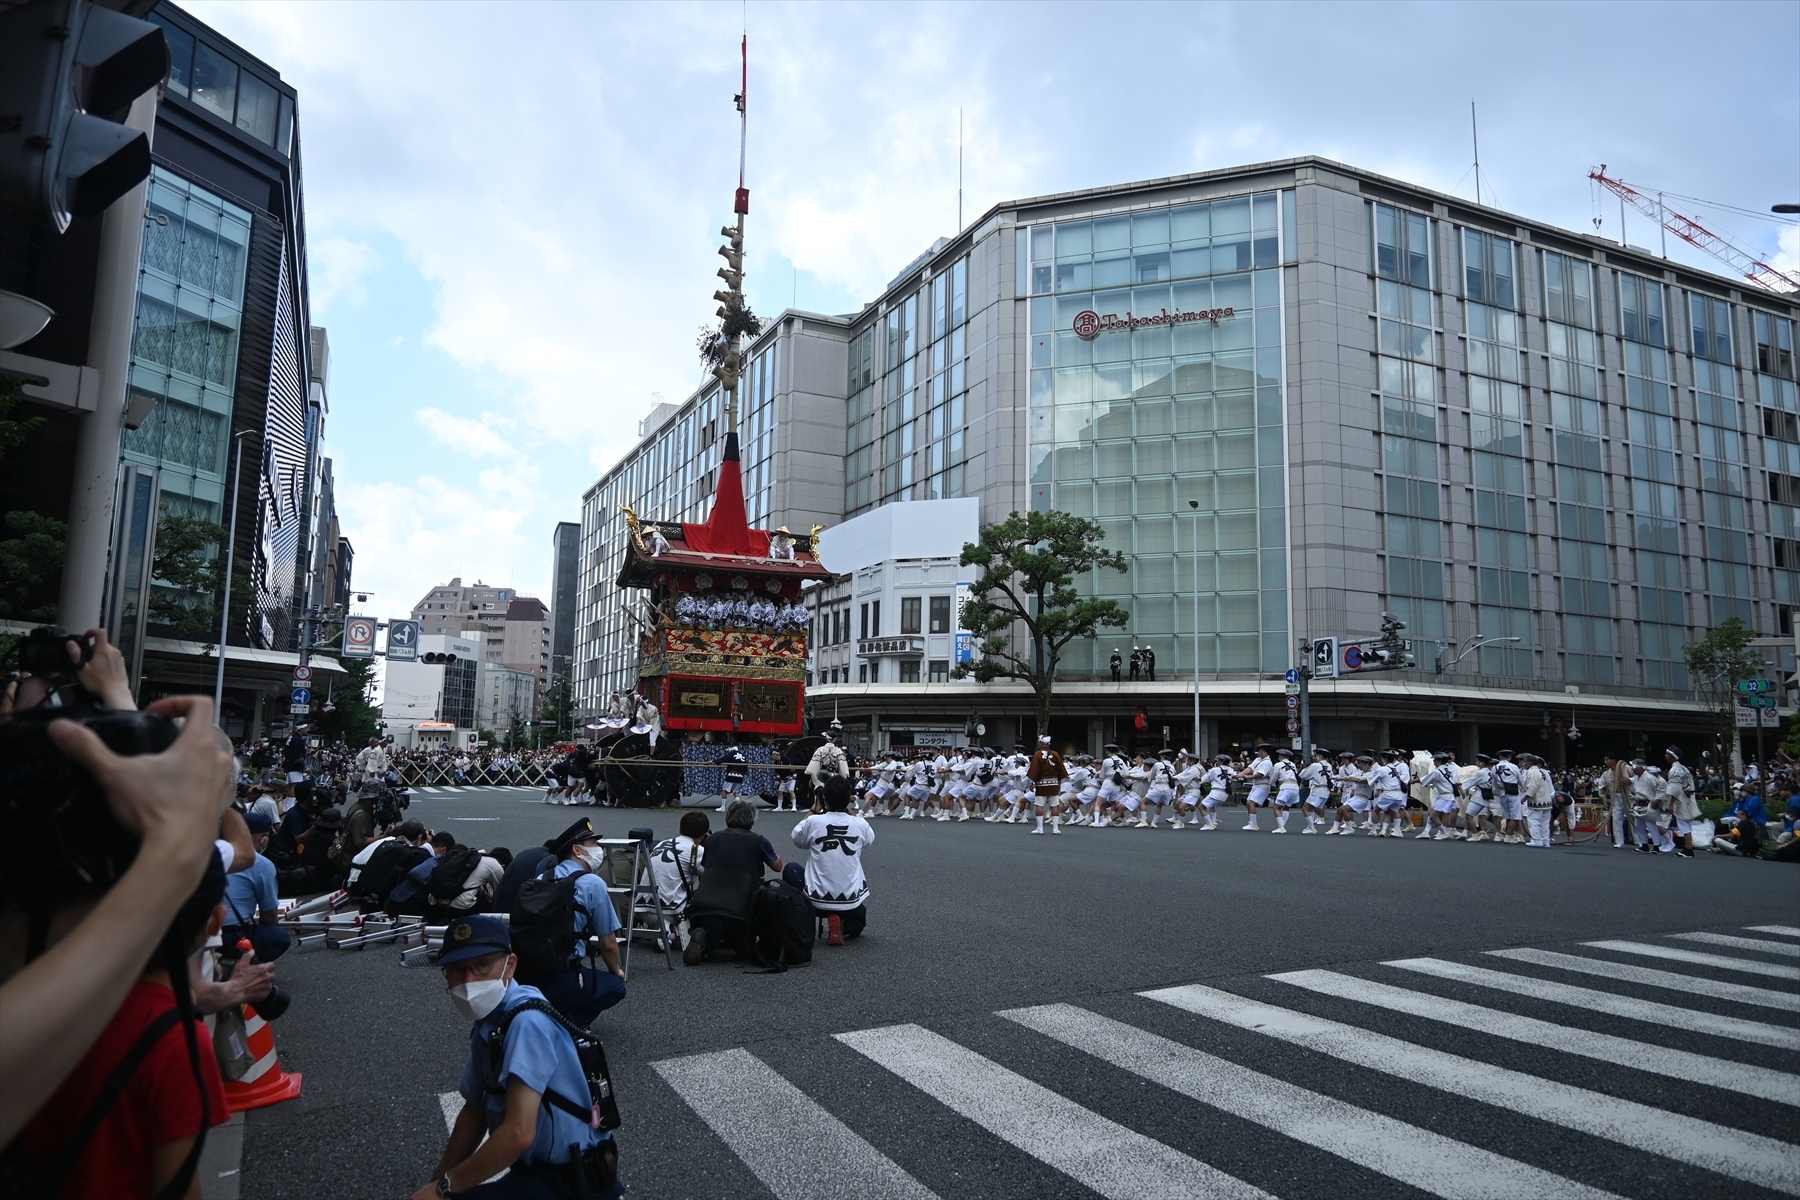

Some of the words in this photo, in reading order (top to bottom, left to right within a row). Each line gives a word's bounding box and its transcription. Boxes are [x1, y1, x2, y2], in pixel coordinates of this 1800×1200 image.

[1102, 307, 1235, 329] Takashimaya
[1749, 682, 1757, 690] 32
[814, 823, 860, 856] 長
